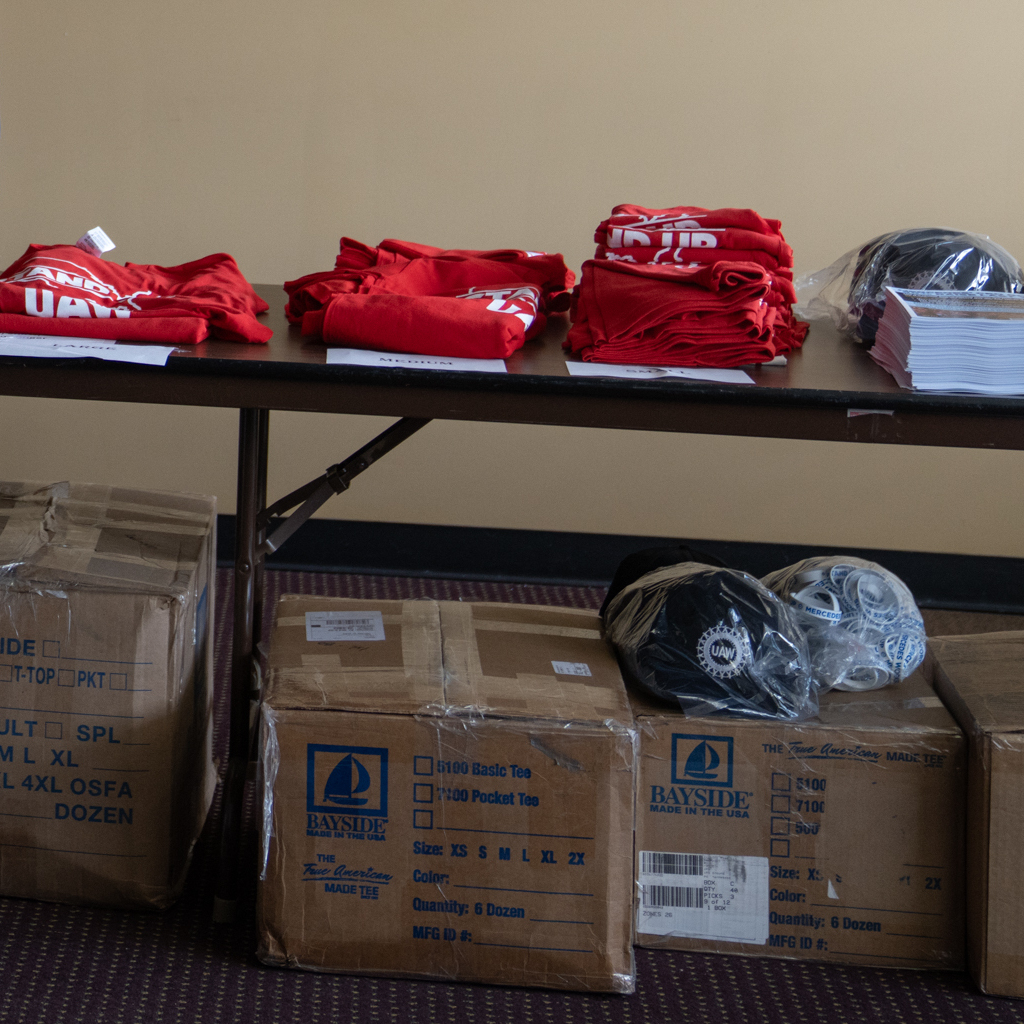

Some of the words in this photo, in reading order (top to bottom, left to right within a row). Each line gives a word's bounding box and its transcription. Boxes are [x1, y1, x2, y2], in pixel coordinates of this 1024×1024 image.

[711, 645, 735, 661] UAW
[14, 665, 55, 685] T-TOP
[77, 670, 106, 689] PKT
[76, 724, 121, 744] SPL
[24, 747, 36, 764] L
[50, 749, 79, 767] XL
[762, 743, 784, 753] THE
[788, 741, 818, 754] True
[820, 742, 882, 759] American
[886, 751, 921, 763] MADE
[922, 753, 946, 765] TEE
[437, 760, 469, 775] 5100
[472, 762, 507, 778] Basic
[510, 764, 532, 779] Tee
[21, 774, 63, 794] 4XL
[70, 777, 133, 799] OSFA
[796, 777, 827, 792] 5100
[437, 787, 469, 802] 7100
[471, 789, 515, 806] Pocket
[517, 792, 540, 807] Tee
[650, 785, 750, 810] BAYSIDE
[795, 799, 825, 813] 7100
[54, 802, 134, 825] DOZEN
[649, 804, 682, 814] MADE
[685, 807, 697, 815] IN
[700, 808, 724, 817] THE
[726, 810, 750, 819] USA
[306, 813, 386, 834] BAYSIDE
[306, 829, 332, 838] MADE
[334, 831, 345, 839] IN
[346, 832, 365, 840] THE
[367, 833, 386, 842] USA
[316, 853, 336, 863] THE
[413, 841, 444, 856] Size:
[450, 843, 468, 858] XS
[479, 845, 488, 859] S
[499, 847, 511, 861] M
[522, 848, 530, 862] L
[541, 850, 558, 864] XL
[568, 851, 586, 866] 2X
[303, 863, 331, 875] True
[333, 864, 394, 881] American
[413, 869, 450, 885] Color:
[770, 865, 800, 880] Size:
[924, 876, 942, 890] 2X
[324, 882, 357, 895] MADE
[358, 885, 379, 896] TEE
[769, 888, 806, 903] Color:
[413, 897, 470, 917] Quantity:
[474, 902, 483, 916] 6
[486, 902, 526, 919] Dozen
[769, 911, 825, 929] Quantity:
[830, 916, 839, 929] 6
[842, 916, 882, 932] Dozen
[413, 925, 441, 941] MFG
[443, 928, 457, 942] ID
[768, 934, 796, 949] MFG
[799, 936, 813, 950] ID
[816, 938, 829, 951] #:
